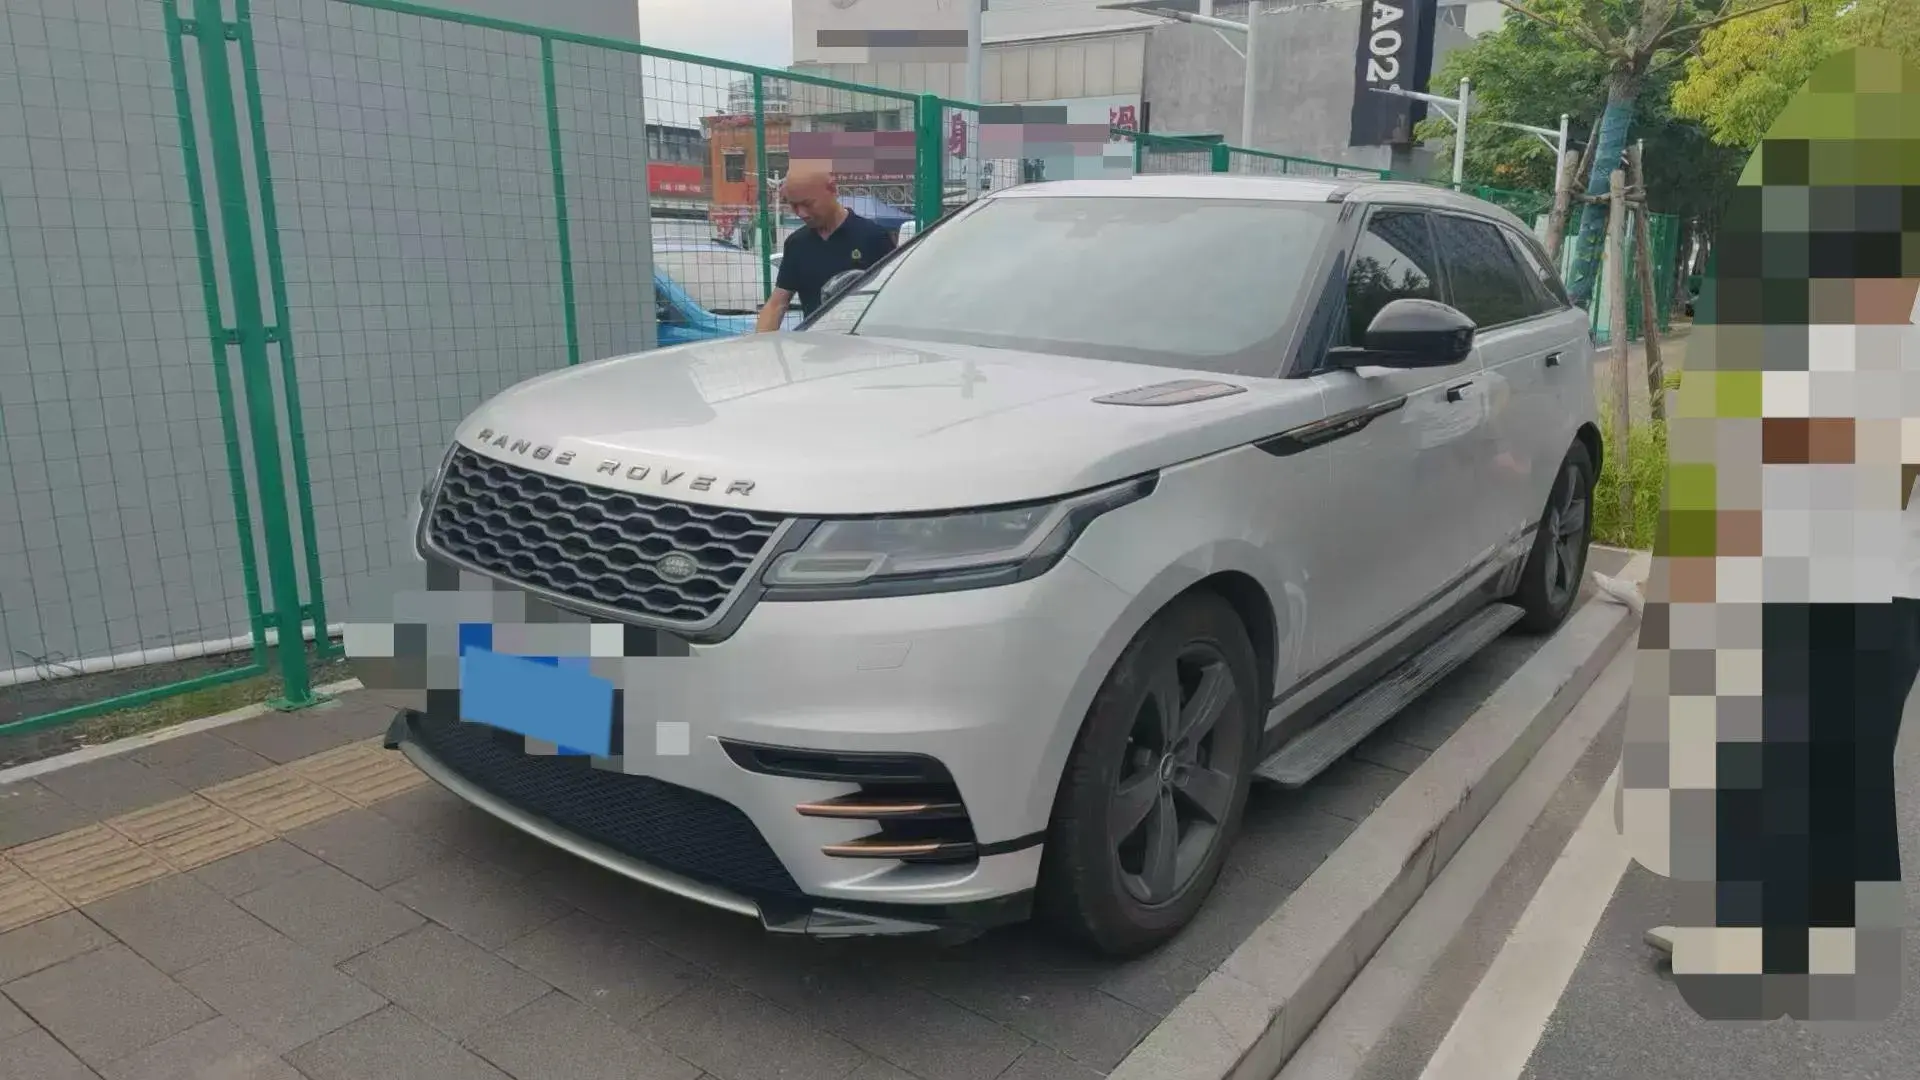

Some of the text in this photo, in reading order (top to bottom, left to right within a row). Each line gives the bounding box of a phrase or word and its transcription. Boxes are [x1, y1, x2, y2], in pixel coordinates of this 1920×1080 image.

[1366, 0, 1404, 83] A02
[477, 427, 756, 497] RANGE ROVER
